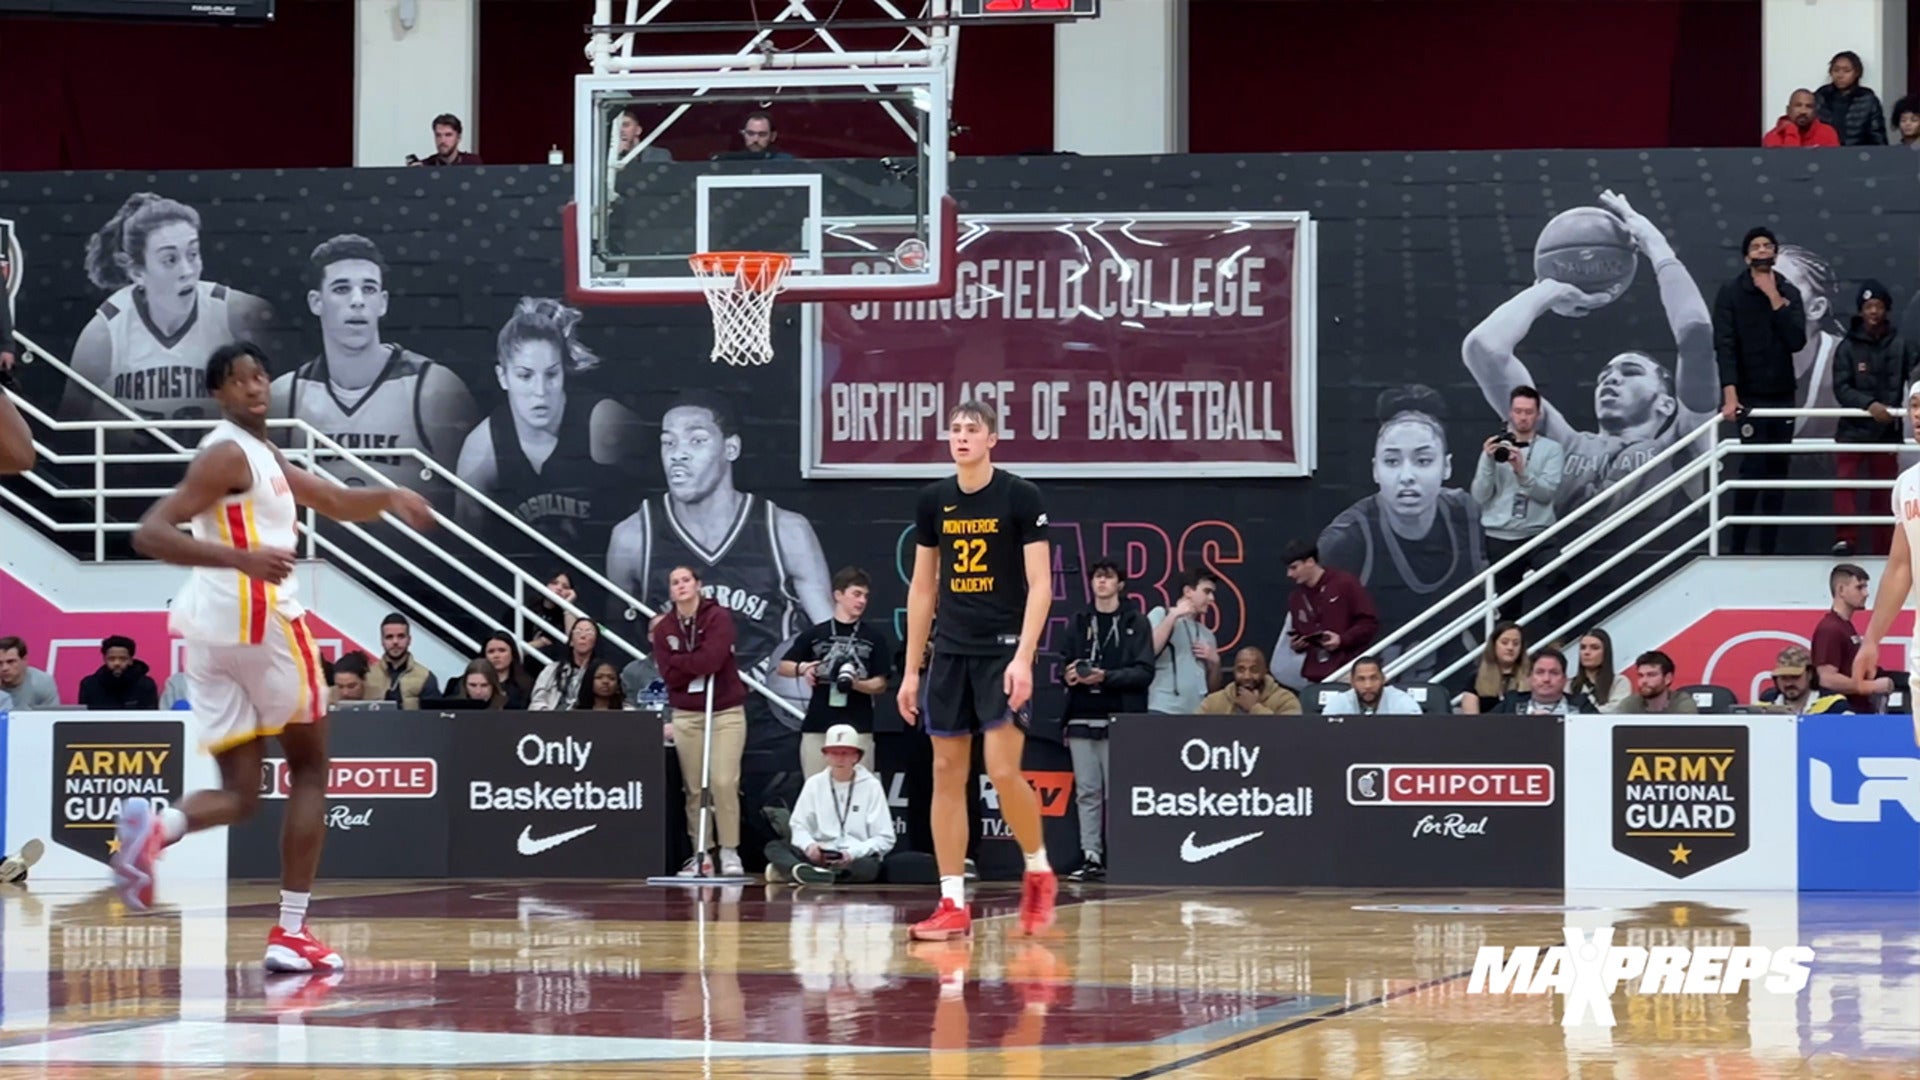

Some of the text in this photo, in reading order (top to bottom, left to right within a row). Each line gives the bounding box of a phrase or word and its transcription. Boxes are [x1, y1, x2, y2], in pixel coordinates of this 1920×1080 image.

[1101, 258, 1266, 318] COLLEGE
[1032, 382, 1070, 440] OF
[1088, 380, 1283, 440] BASKETBALL
[942, 518, 1000, 534] MONTVERDE
[953, 538, 988, 573] 32
[895, 520, 1246, 653] SARS
[951, 577, 994, 592] ACADEMY
[66, 750, 169, 776] ARMY
[516, 734, 592, 772] Only
[1181, 738, 1261, 777] Only
[1627, 755, 1734, 782] ARMY
[65, 778, 170, 795] NATIONAL
[470, 781, 643, 810] Basketball
[1394, 774, 1543, 795] CHIPOTLE
[1626, 784, 1735, 801] NATIONAL
[64, 797, 170, 821] GUAD
[1131, 786, 1313, 816] Basketball
[329, 805, 374, 831] Real
[1412, 813, 1488, 839] for Real
[1625, 803, 1736, 829] GUARD
